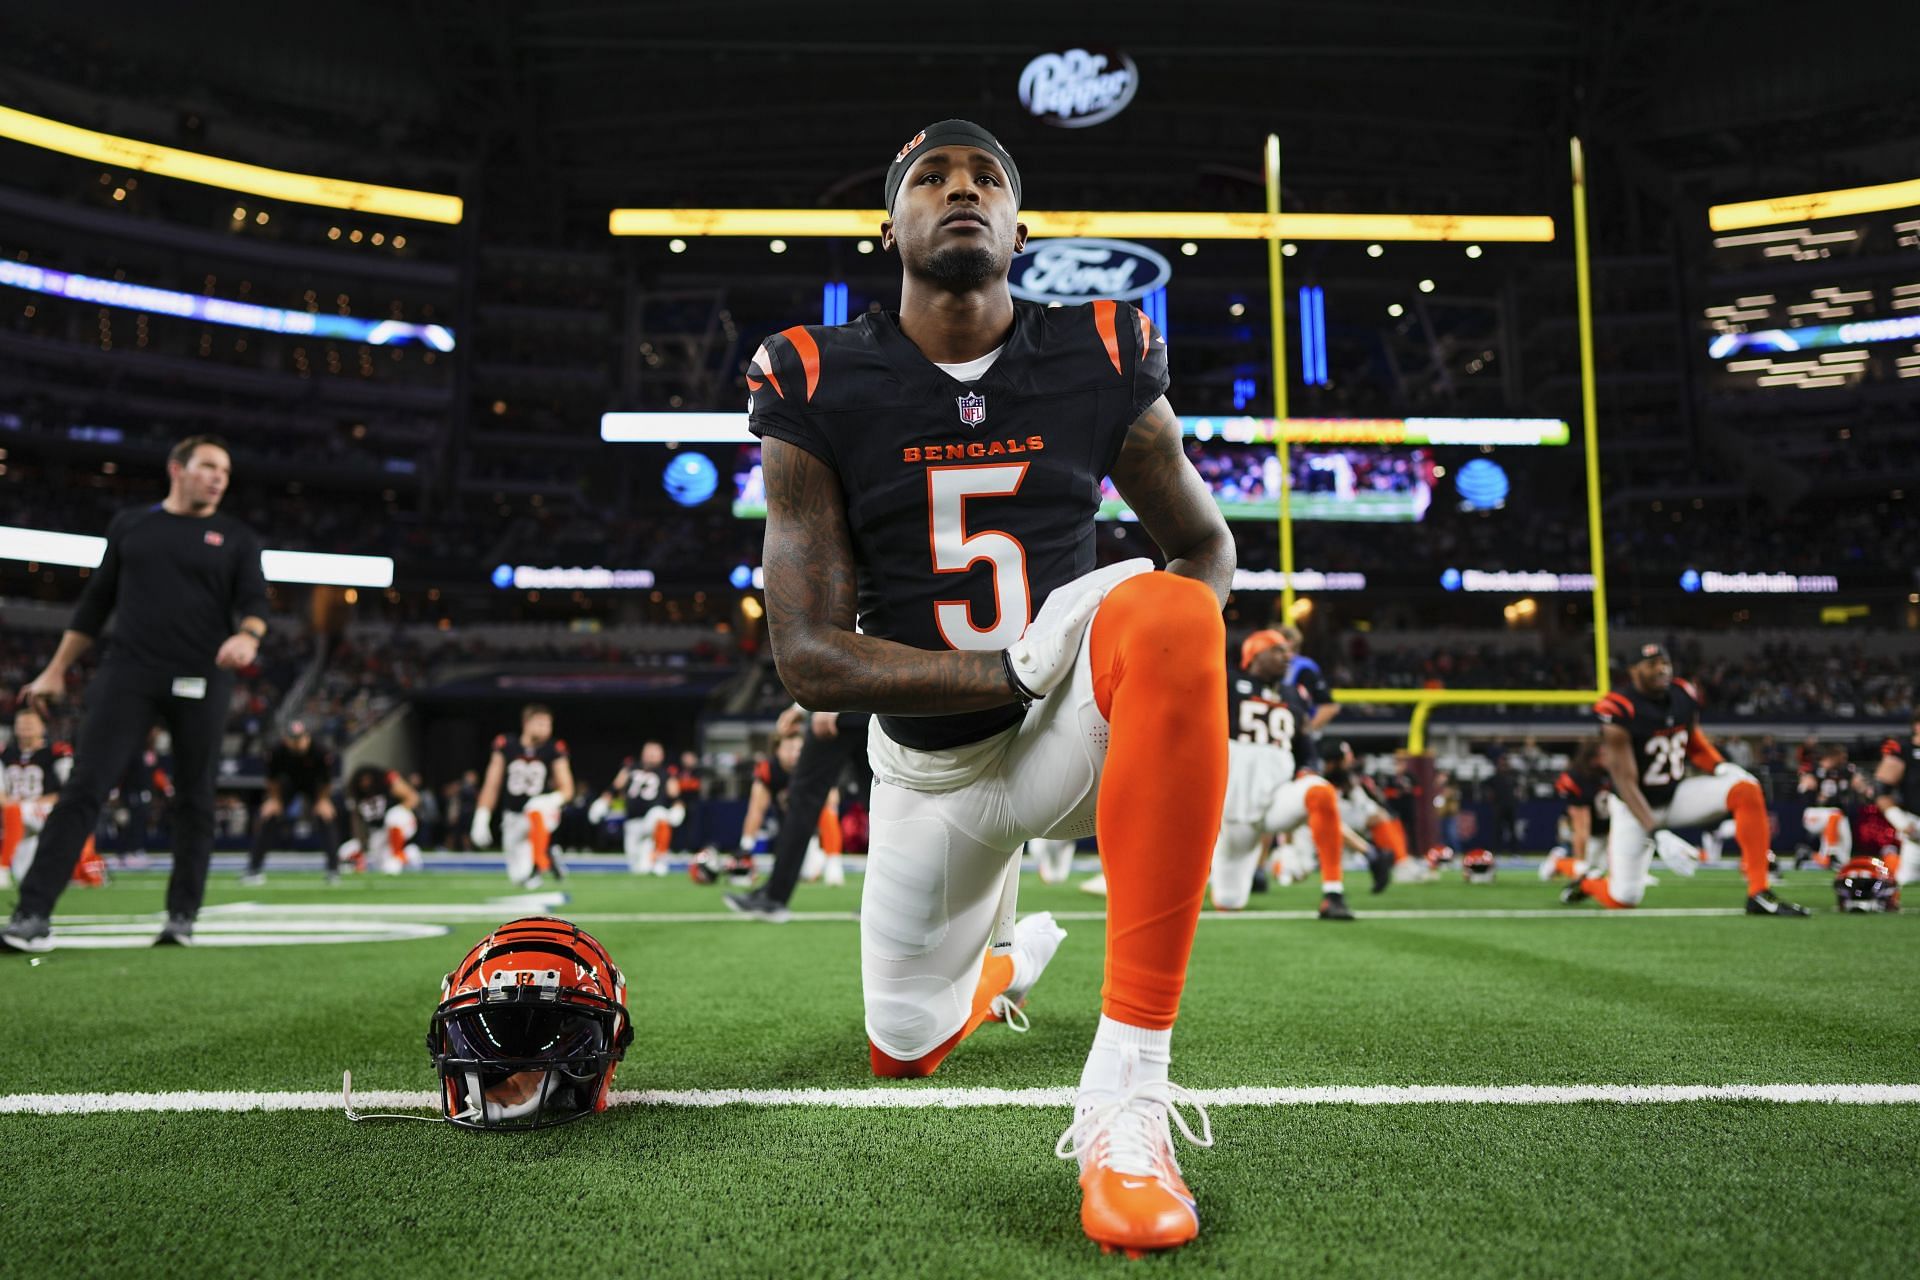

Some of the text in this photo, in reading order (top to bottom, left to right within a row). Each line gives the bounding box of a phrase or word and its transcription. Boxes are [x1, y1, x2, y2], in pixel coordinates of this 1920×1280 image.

[1027, 53, 1132, 118] Pepper
[1062, 48, 1108, 79] Dr
[1022, 246, 1138, 294] Ford
[963, 407, 983, 421] NFL
[903, 436, 1044, 463] BENGALS
[926, 462, 1031, 651] 5
[1238, 700, 1295, 751] 59
